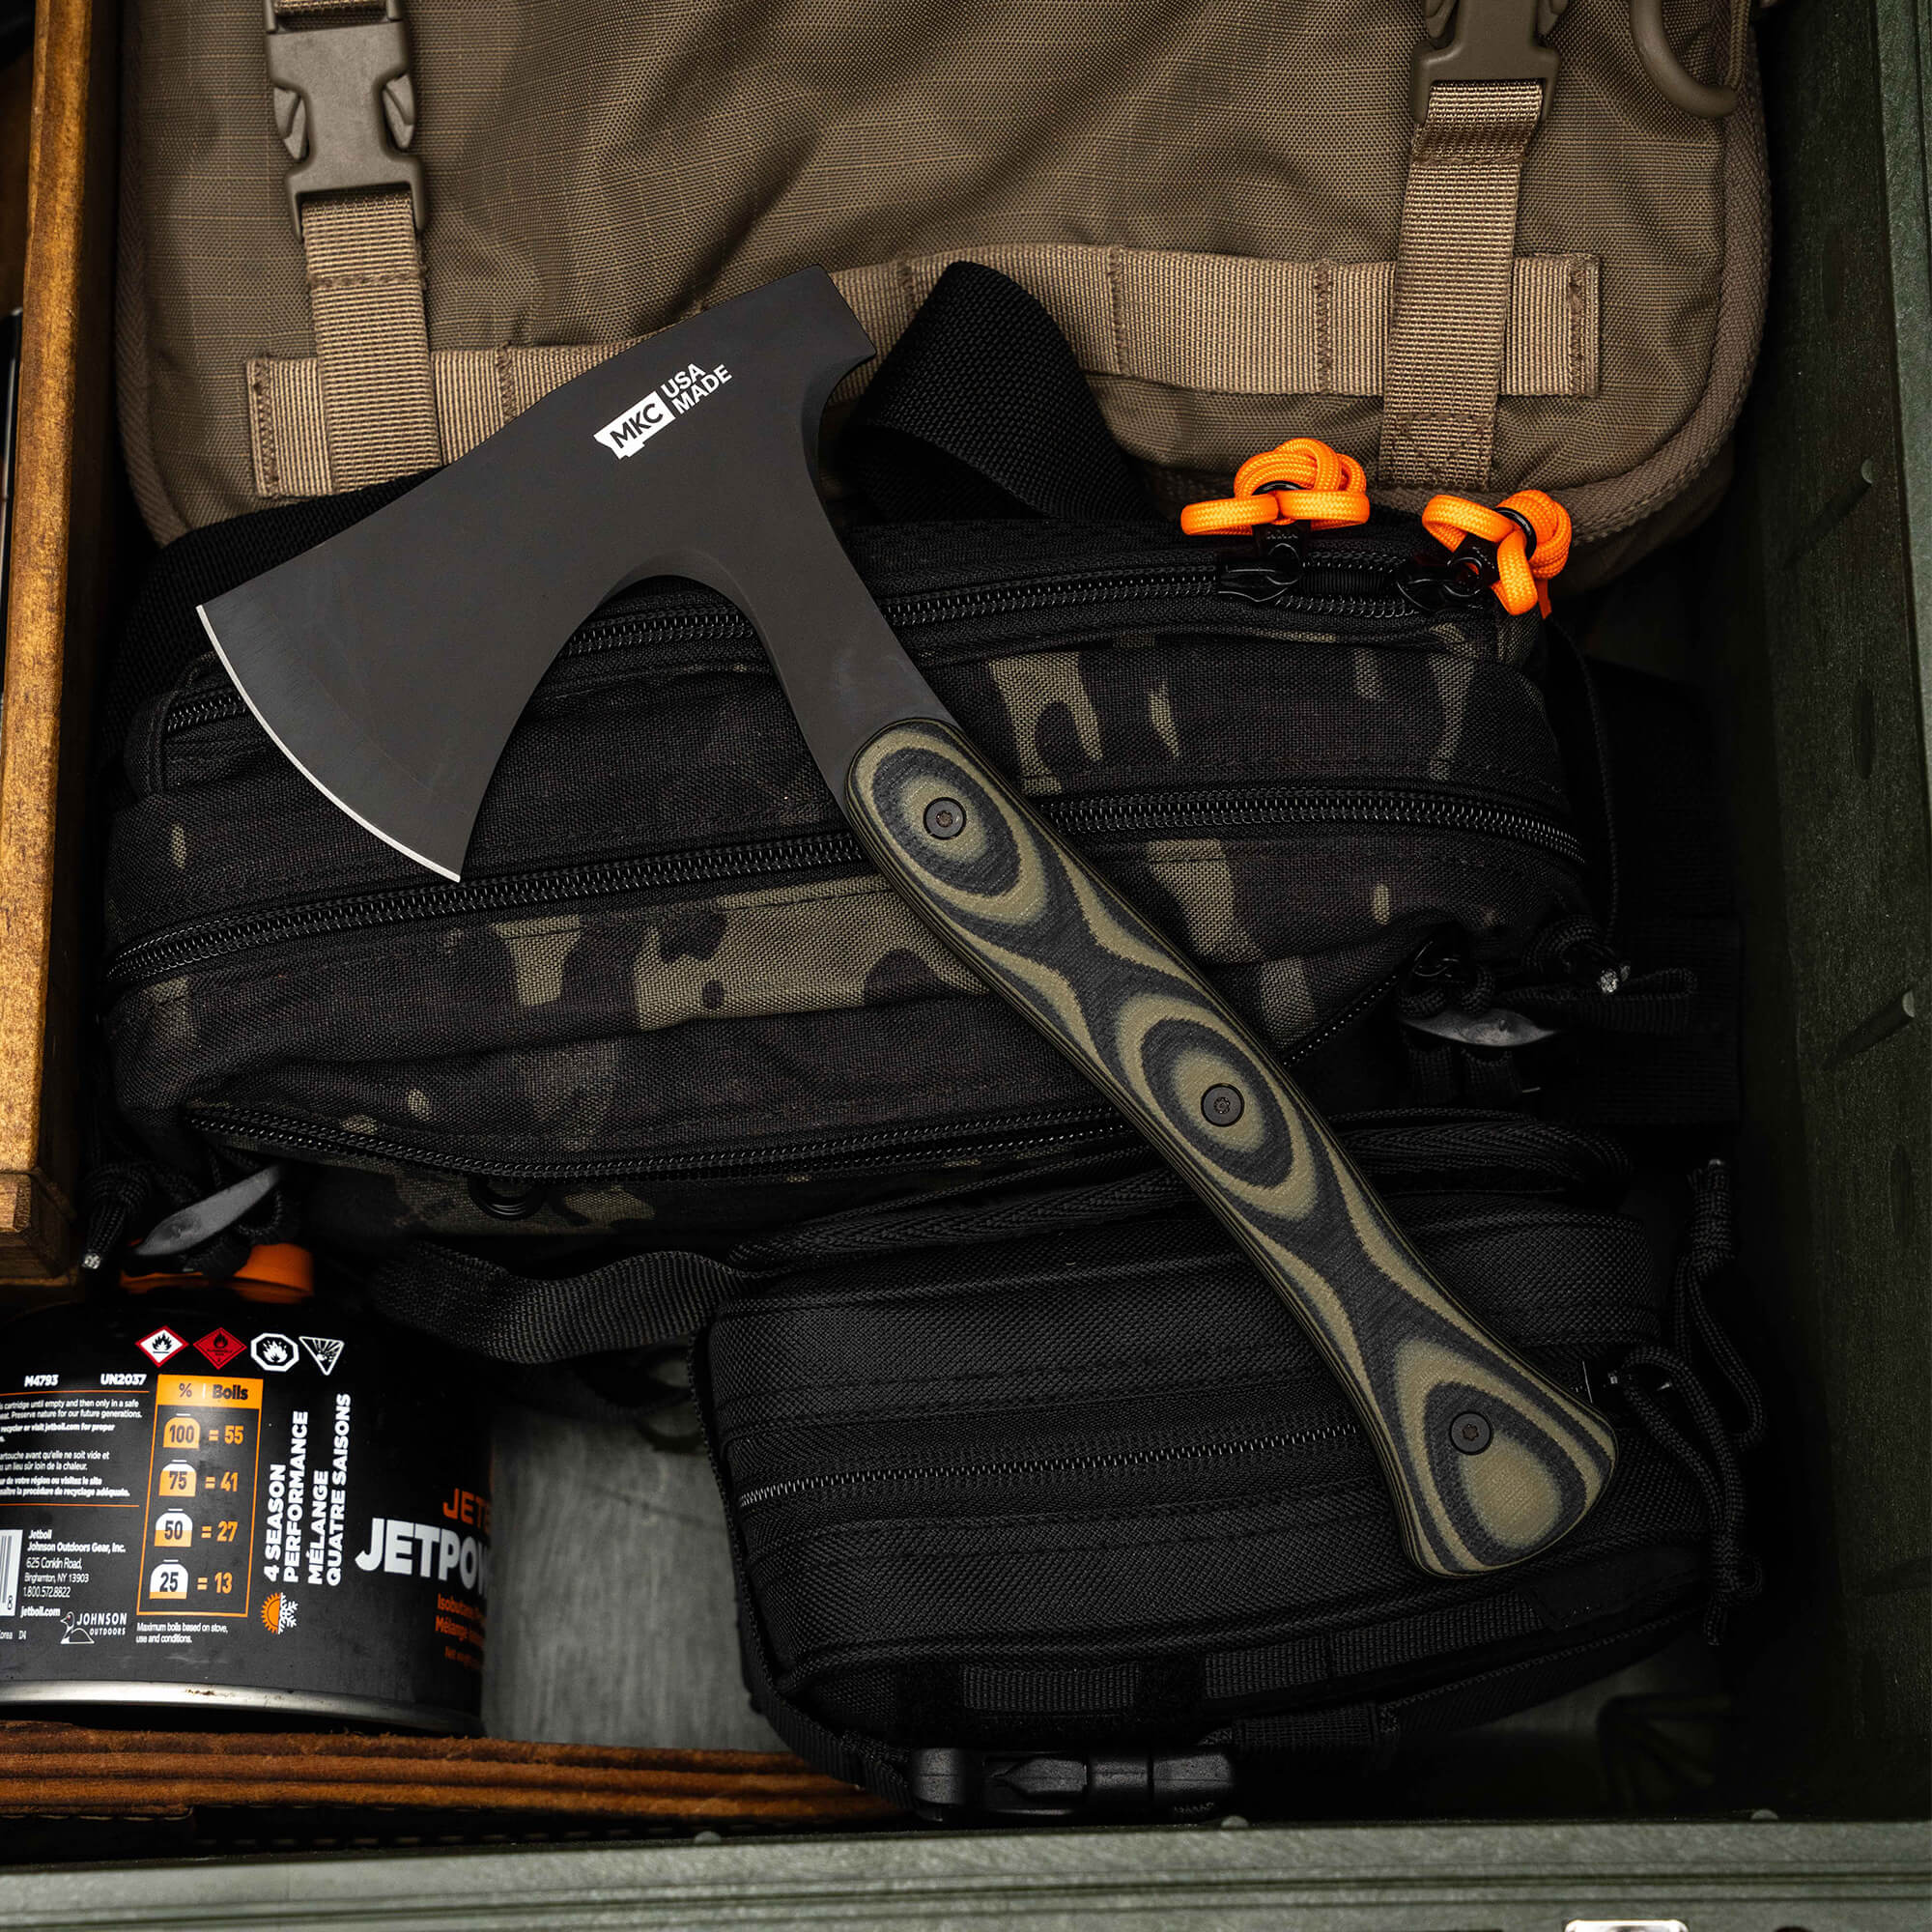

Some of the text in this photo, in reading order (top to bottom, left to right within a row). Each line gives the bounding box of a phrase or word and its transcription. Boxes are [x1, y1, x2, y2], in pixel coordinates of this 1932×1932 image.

[661, 363, 707, 399] USA
[671, 363, 732, 414] MADE
[610, 403, 664, 449] MKC
[24, 1374, 147, 1387] M4793 UN2037
[179, 1382, 249, 1400] % Boils
[4, 1400, 30, 1410] cartridge
[31, 1400, 44, 1408] until
[44, 1399, 65, 1409] empty
[66, 1399, 78, 1407] and
[79, 1399, 95, 1407] then
[96, 1399, 110, 1409] only
[111, 1399, 118, 1407] in
[125, 1399, 139, 1407] safe
[58, 1409, 67, 1418] for
[80, 1408, 99, 1417] future
[100, 1409, 142, 1419] generations.
[31, 1423, 44, 1432] visit
[44, 1422, 80, 1433] jetboil.com
[92, 1424, 115, 1433] proper
[169, 1424, 195, 1443] 100
[224, 1425, 244, 1445] 55
[25, 1451, 42, 1460] avant
[73, 1450, 86, 1460] soit
[87, 1450, 101, 1460] vide
[102, 1451, 110, 1460] et
[13, 1462, 23, 1470] lieu
[35, 1461, 45, 1469] loin
[46, 1461, 56, 1469] de
[56, 1461, 62, 1469] la
[63, 1461, 87, 1470] chaleur.
[6, 1476, 14, 1485] de
[14, 1476, 30, 1485] votre
[82, 1476, 89, 1485] le
[90, 1476, 102, 1485] site
[169, 1470, 187, 1491] 75
[220, 1471, 239, 1492] 41
[54, 1487, 63, 1495] de
[64, 1487, 95, 1497] recyclage
[283, 1410, 308, 1582] PERFORMANCE
[327, 1393, 351, 1586] QUATRE SAISONS
[264, 1463, 286, 1582] 4 SEASON
[306, 1470, 328, 1584] MÉLANGE
[28, 1529, 52, 1540] Jetboil
[164, 1520, 184, 1540] 50
[216, 1520, 239, 1542] 27
[27, 1542, 127, 1554] Johnson Outdoors Gear, Inc.
[26, 1557, 41, 1569] 625
[64, 1557, 83, 1570] Road,
[58, 1573, 69, 1582] NY
[70, 1573, 89, 1583] 13903
[159, 1572, 179, 1592] 25
[214, 1572, 233, 1594] 13
[8, 1595, 13, 1610] 8
[20, 1605, 61, 1618] jetboil.com
[76, 1612, 128, 1626] JOHNSON
[89, 1627, 127, 1635] OUTDOORS
[136, 1622, 166, 1632] Maximum
[167, 1623, 182, 1633] boils
[182, 1623, 202, 1633] based
[211, 1624, 229, 1634] stove,
[135, 1634, 193, 1643] use and conditions.
